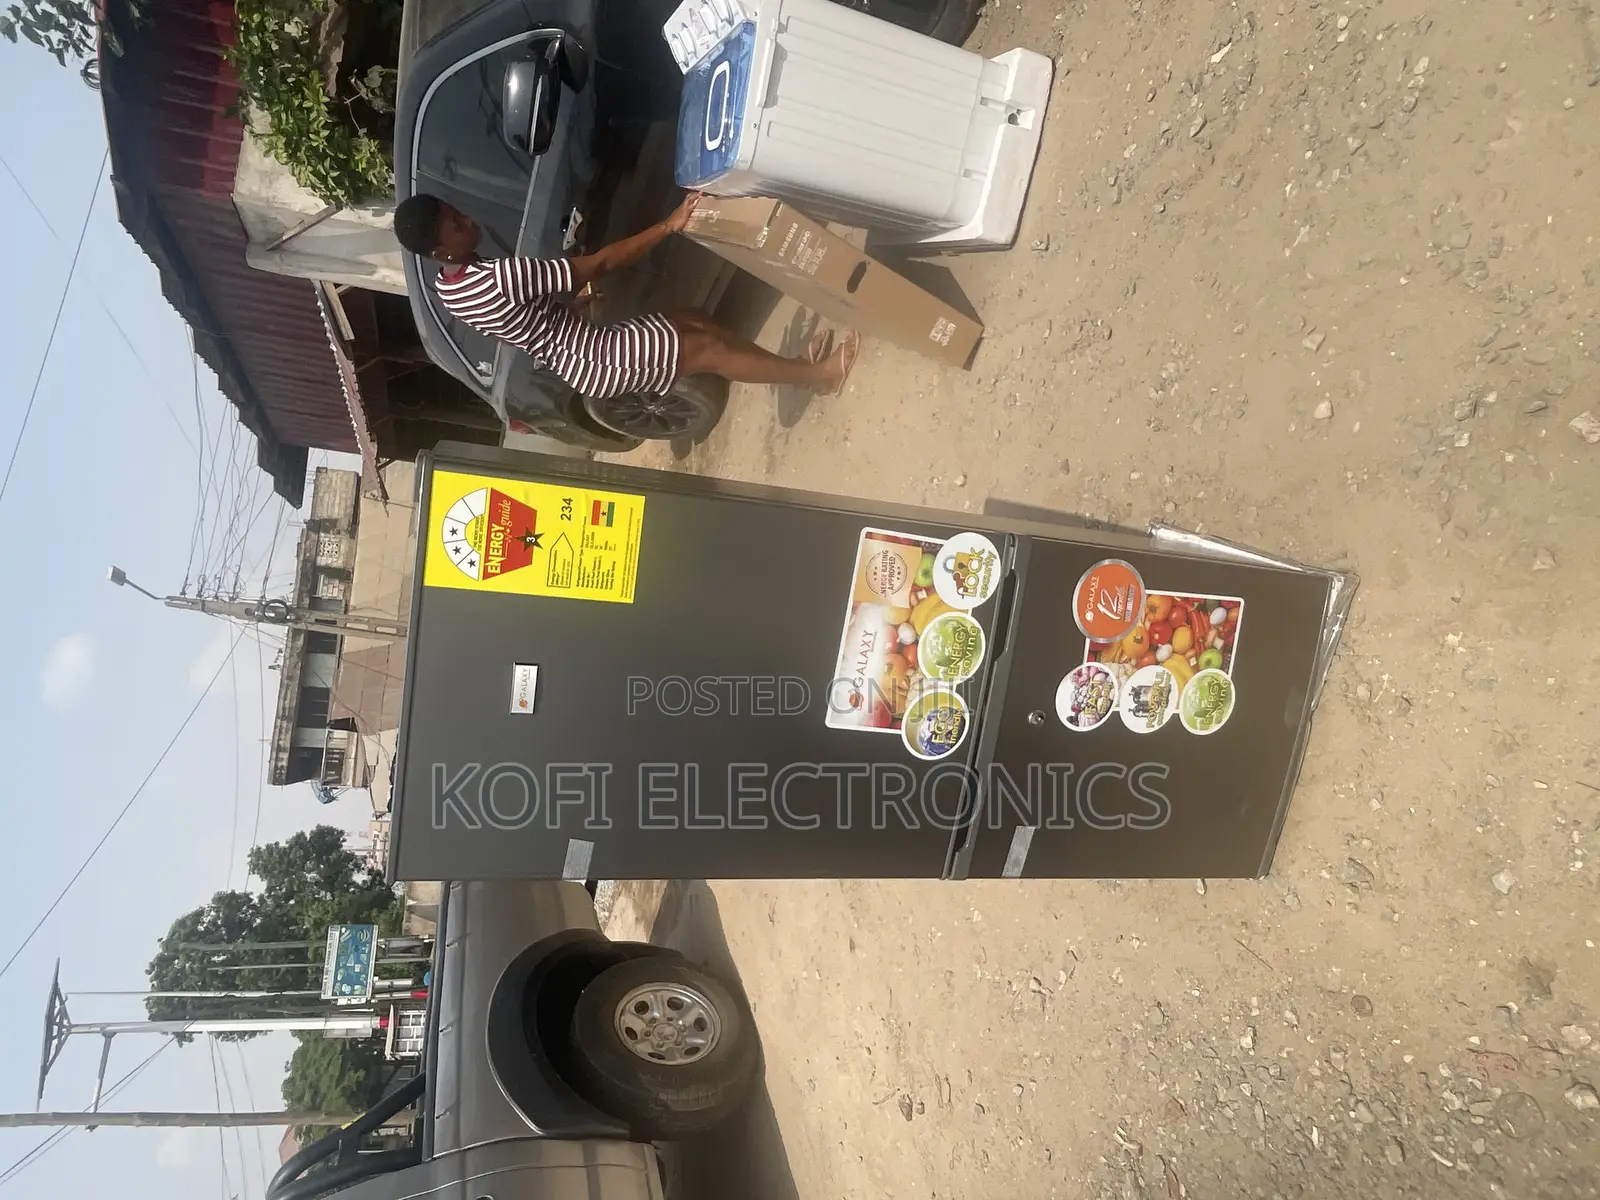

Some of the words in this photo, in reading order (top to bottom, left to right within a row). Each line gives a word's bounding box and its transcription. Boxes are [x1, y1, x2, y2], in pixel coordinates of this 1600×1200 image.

[777, 222, 799, 258] SAMSUNG
[560, 497, 573, 522] 234
[485, 523, 506, 574] ENERGY
[498, 499, 513, 527] guide
[880, 549, 889, 573] RATING
[887, 556, 896, 591] APPROVED
[963, 547, 985, 599] LOCK
[979, 550, 998, 599] security
[1086, 575, 1097, 610] GALAXY
[1097, 588, 1120, 620] 12
[852, 629, 874, 688] GALAXY
[949, 620, 967, 675] ENERGY
[962, 626, 980, 676] saving
[519, 668, 528, 699] GALAXY
[1083, 678, 1101, 716] FAST
[1146, 669, 1165, 728] POWERFUL
[1204, 676, 1220, 725] ENERGY
[931, 706, 950, 744] ECO
